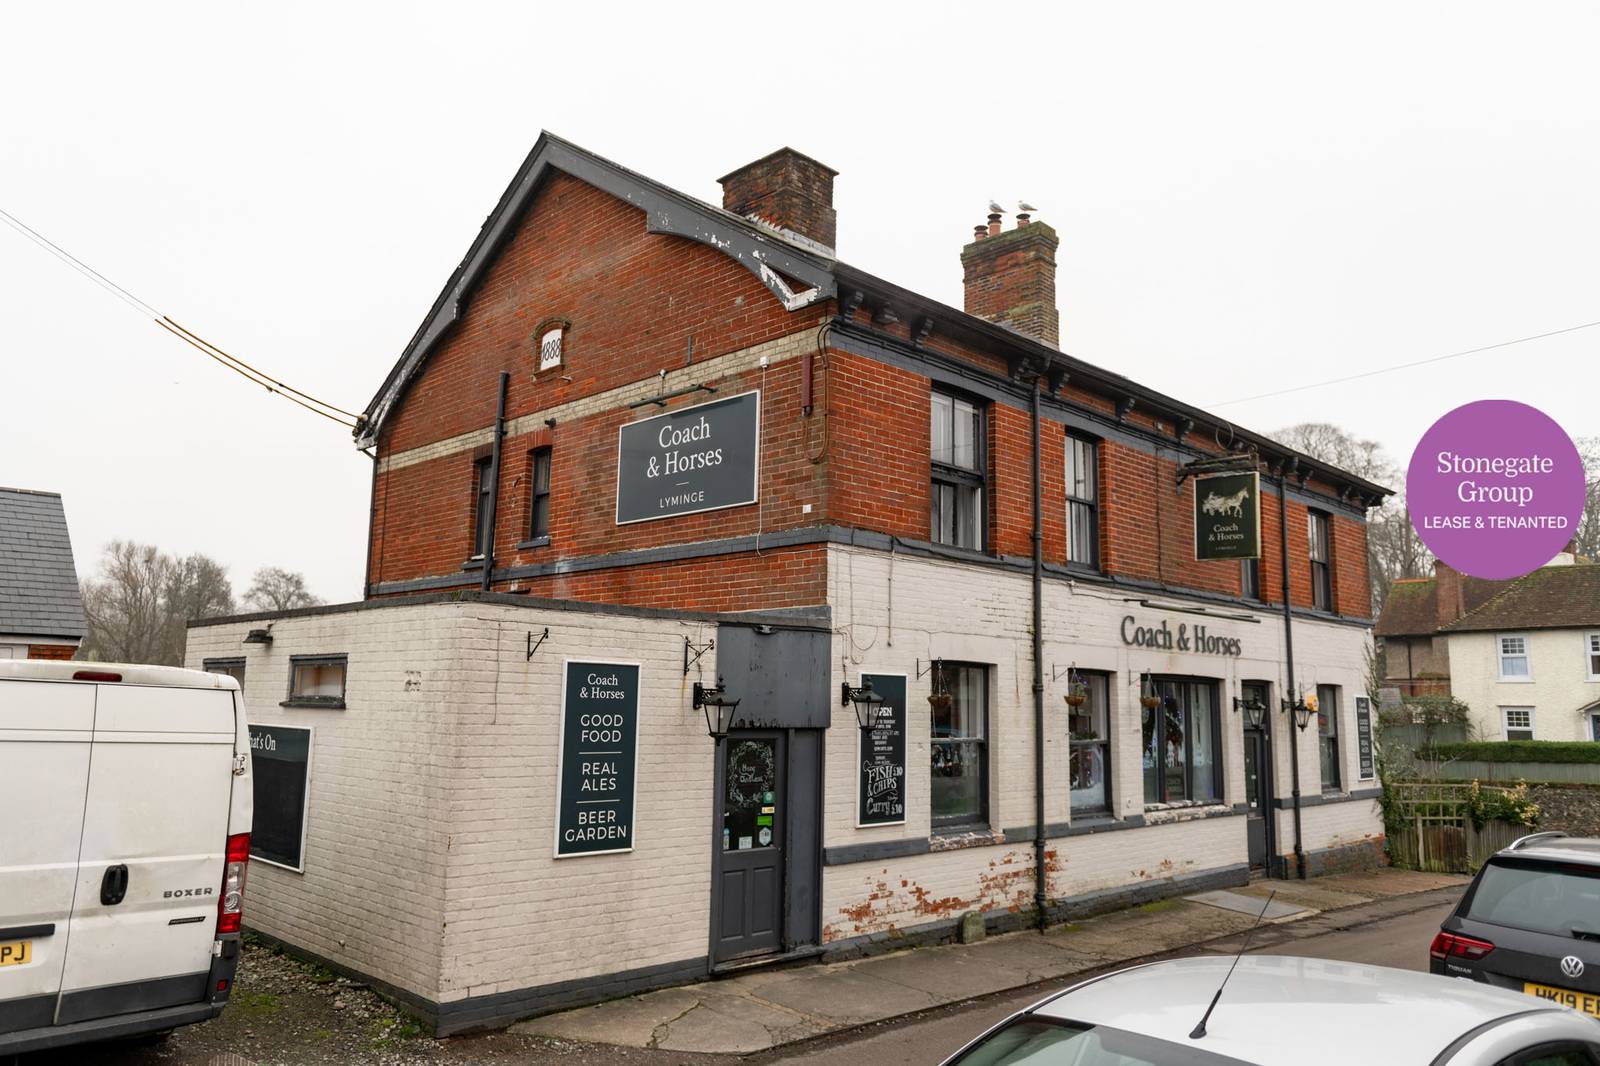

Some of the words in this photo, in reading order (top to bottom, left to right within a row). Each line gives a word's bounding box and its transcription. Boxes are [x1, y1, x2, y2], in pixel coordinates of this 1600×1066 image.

[542, 338, 561, 361] 1888
[659, 416, 710, 448] Coach
[646, 456, 660, 478] &
[665, 448, 722, 475] Horses
[659, 490, 705, 509] LYMINGE
[1213, 523, 1239, 532] Coach
[1208, 533, 1215, 541] &
[1217, 533, 1244, 541] Horses
[1120, 615, 1173, 650] Coach
[1176, 622, 1190, 651] &
[1194, 624, 1242, 656] Horses
[587, 673, 618, 686] Coach
[579, 687, 589, 698] &
[591, 687, 625, 700] Horses
[580, 714, 624, 727] GOOD
[249, 731, 264, 750] hat's
[265, 734, 276, 751] On
[581, 730, 622, 743] FOOD
[582, 762, 618, 775] REAL
[867, 765, 893, 783] FISH
[581, 777, 617, 792] ALES
[873, 777, 897, 795] CHIPS
[866, 797, 891, 816] Curry
[578, 811, 616, 825] BEER
[565, 826, 627, 842] GARDEN
[163, 887, 213, 898] BOXER
[1, 942, 26, 963] PJ
